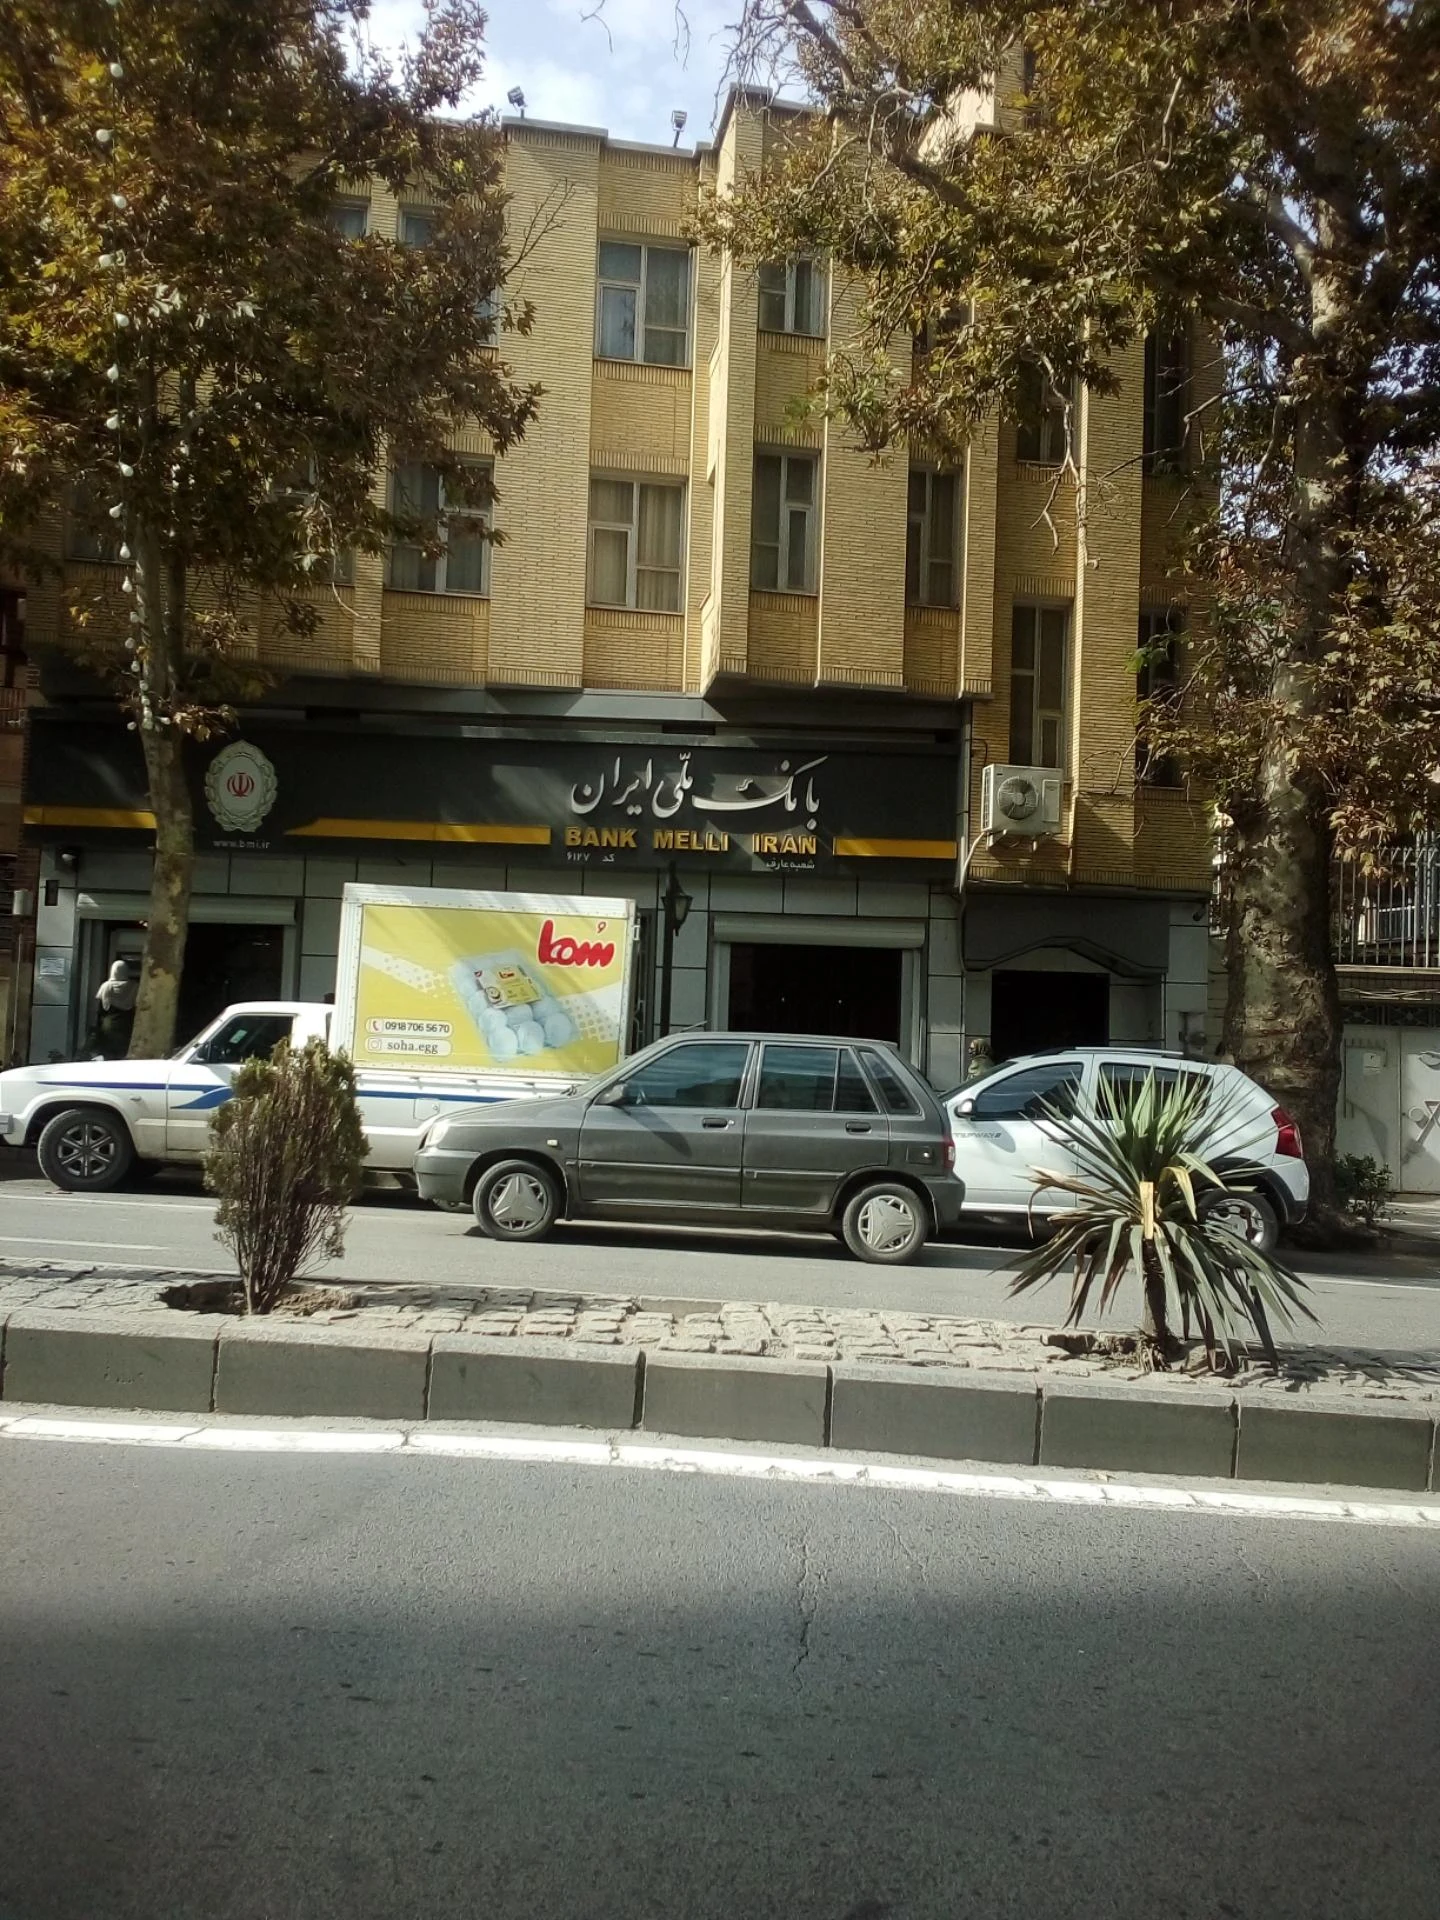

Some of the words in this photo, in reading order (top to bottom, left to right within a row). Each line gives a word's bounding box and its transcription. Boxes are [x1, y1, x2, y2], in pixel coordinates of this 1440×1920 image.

[571, 756, 652, 816] ایران
[212, 839, 271, 849] www.bmi.ir
[564, 826, 638, 848] BANK
[653, 828, 729, 852] MELLI
[752, 832, 817, 855] IRAN
[387, 1040, 439, 1055] soha.egg
